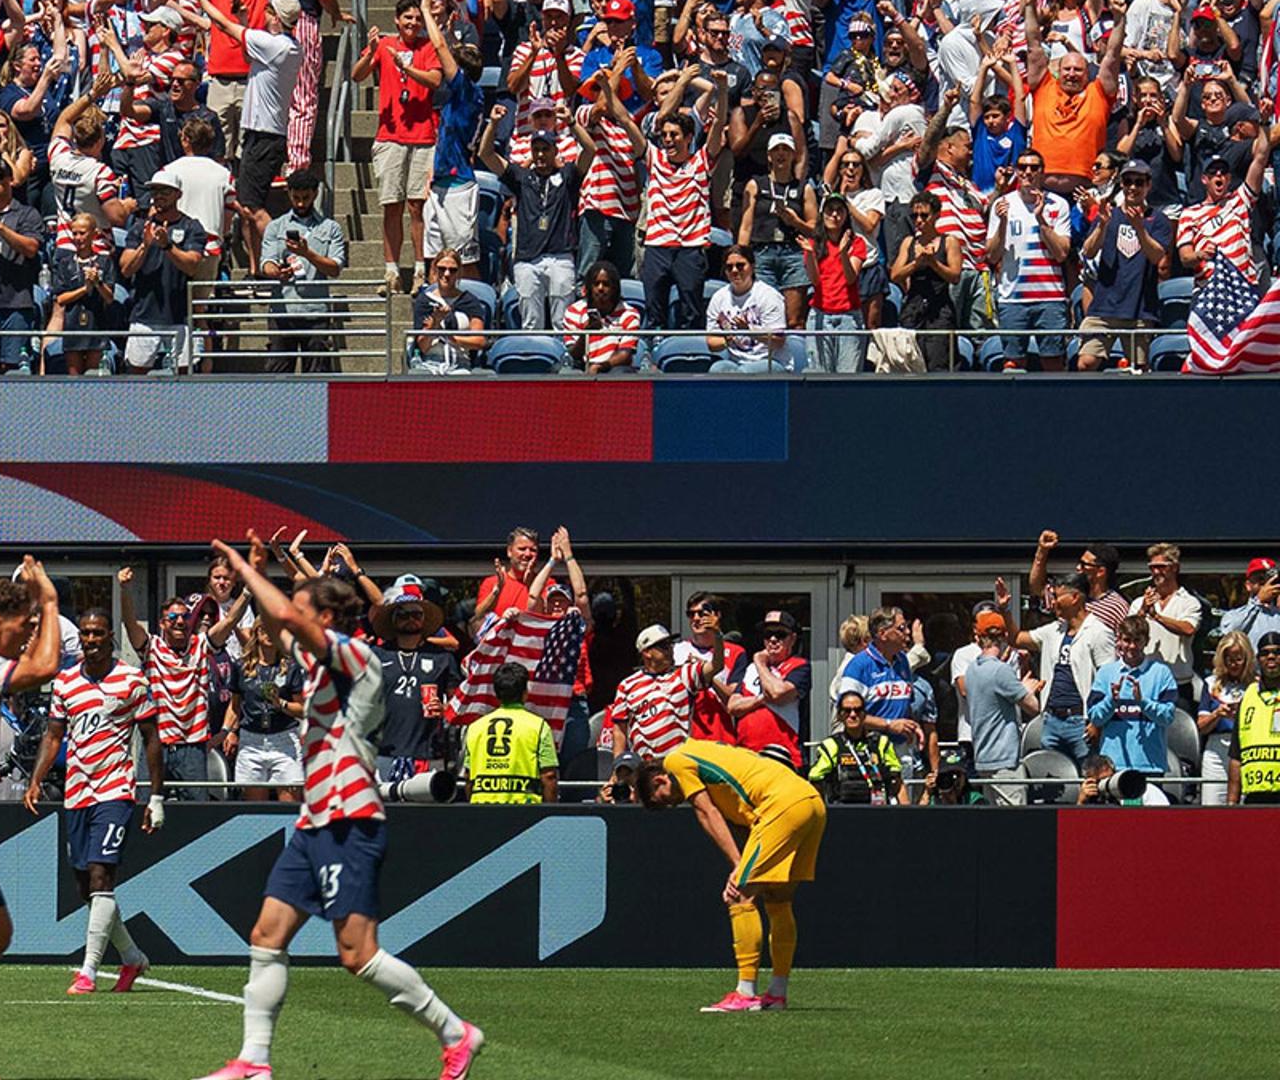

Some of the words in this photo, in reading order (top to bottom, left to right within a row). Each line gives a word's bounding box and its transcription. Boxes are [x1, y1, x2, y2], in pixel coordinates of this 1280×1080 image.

[1009, 219, 1022, 237] 10
[75, 712, 101, 735] 19
[1240, 748, 1280, 764] SECURIT
[474, 776, 530, 792] ECURITY
[102, 823, 126, 848] 19
